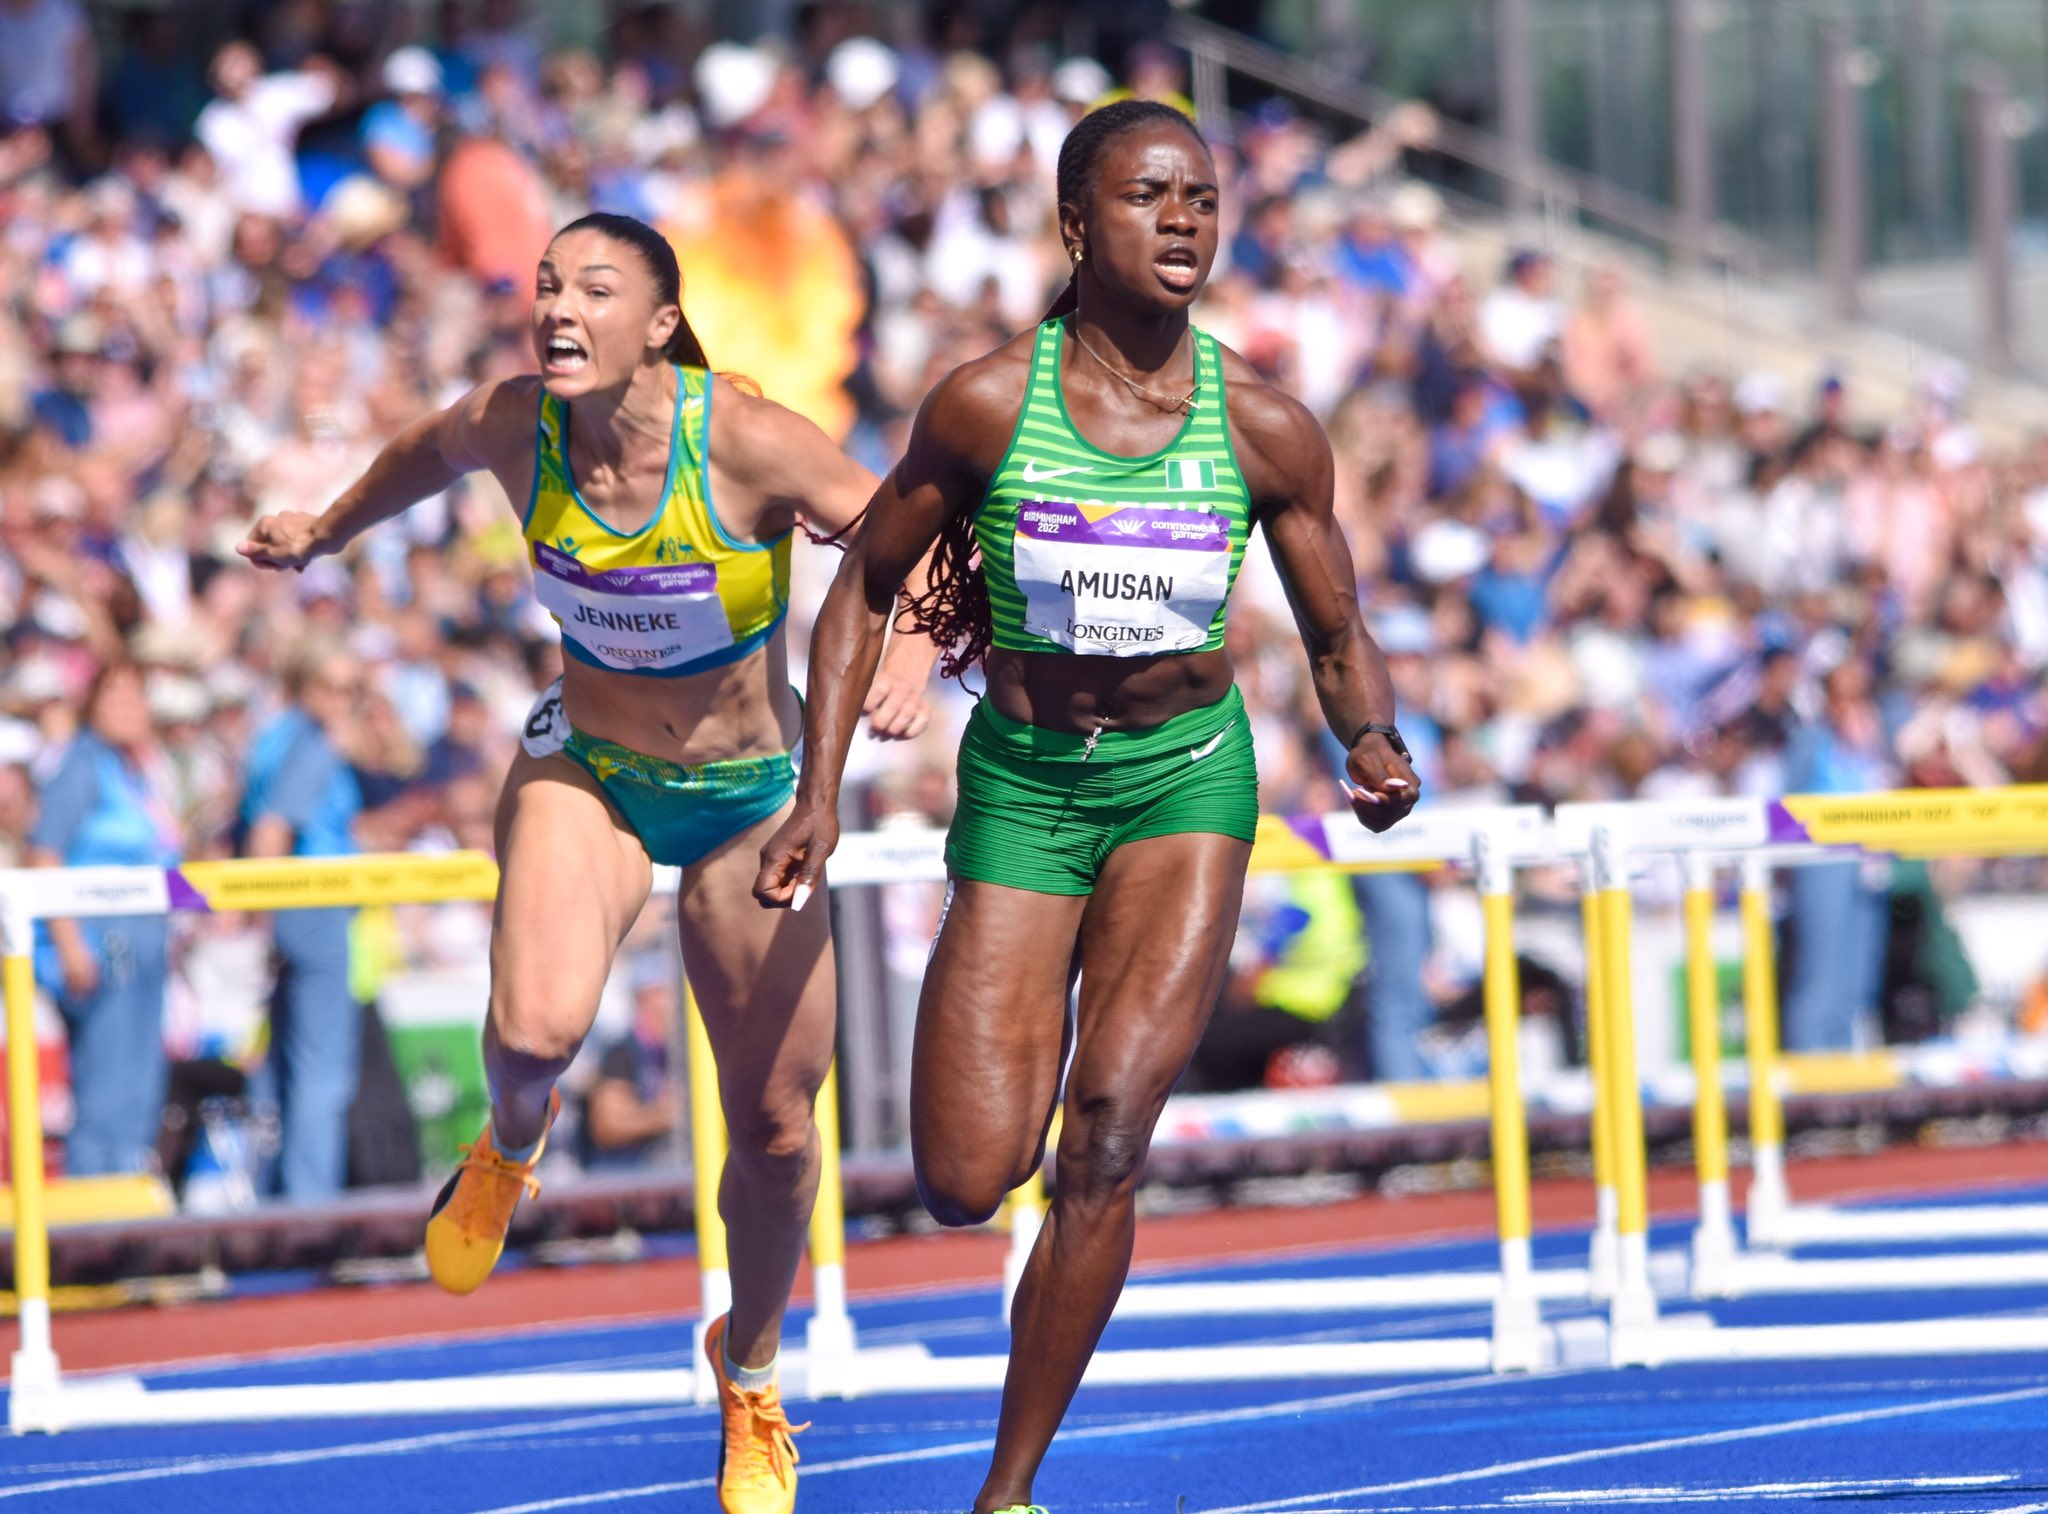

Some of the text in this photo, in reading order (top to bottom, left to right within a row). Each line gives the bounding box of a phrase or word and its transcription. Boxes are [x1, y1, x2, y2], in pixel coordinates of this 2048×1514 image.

[1023, 511, 1077, 526] BIRMINGHAM
[1037, 522, 1059, 534] 2022
[1171, 530, 1204, 541] games
[660, 578, 692, 589] games
[1060, 569, 1174, 602] AMUSAN
[574, 604, 681, 632] JENNEKE
[1066, 617, 1164, 642] LONGINES
